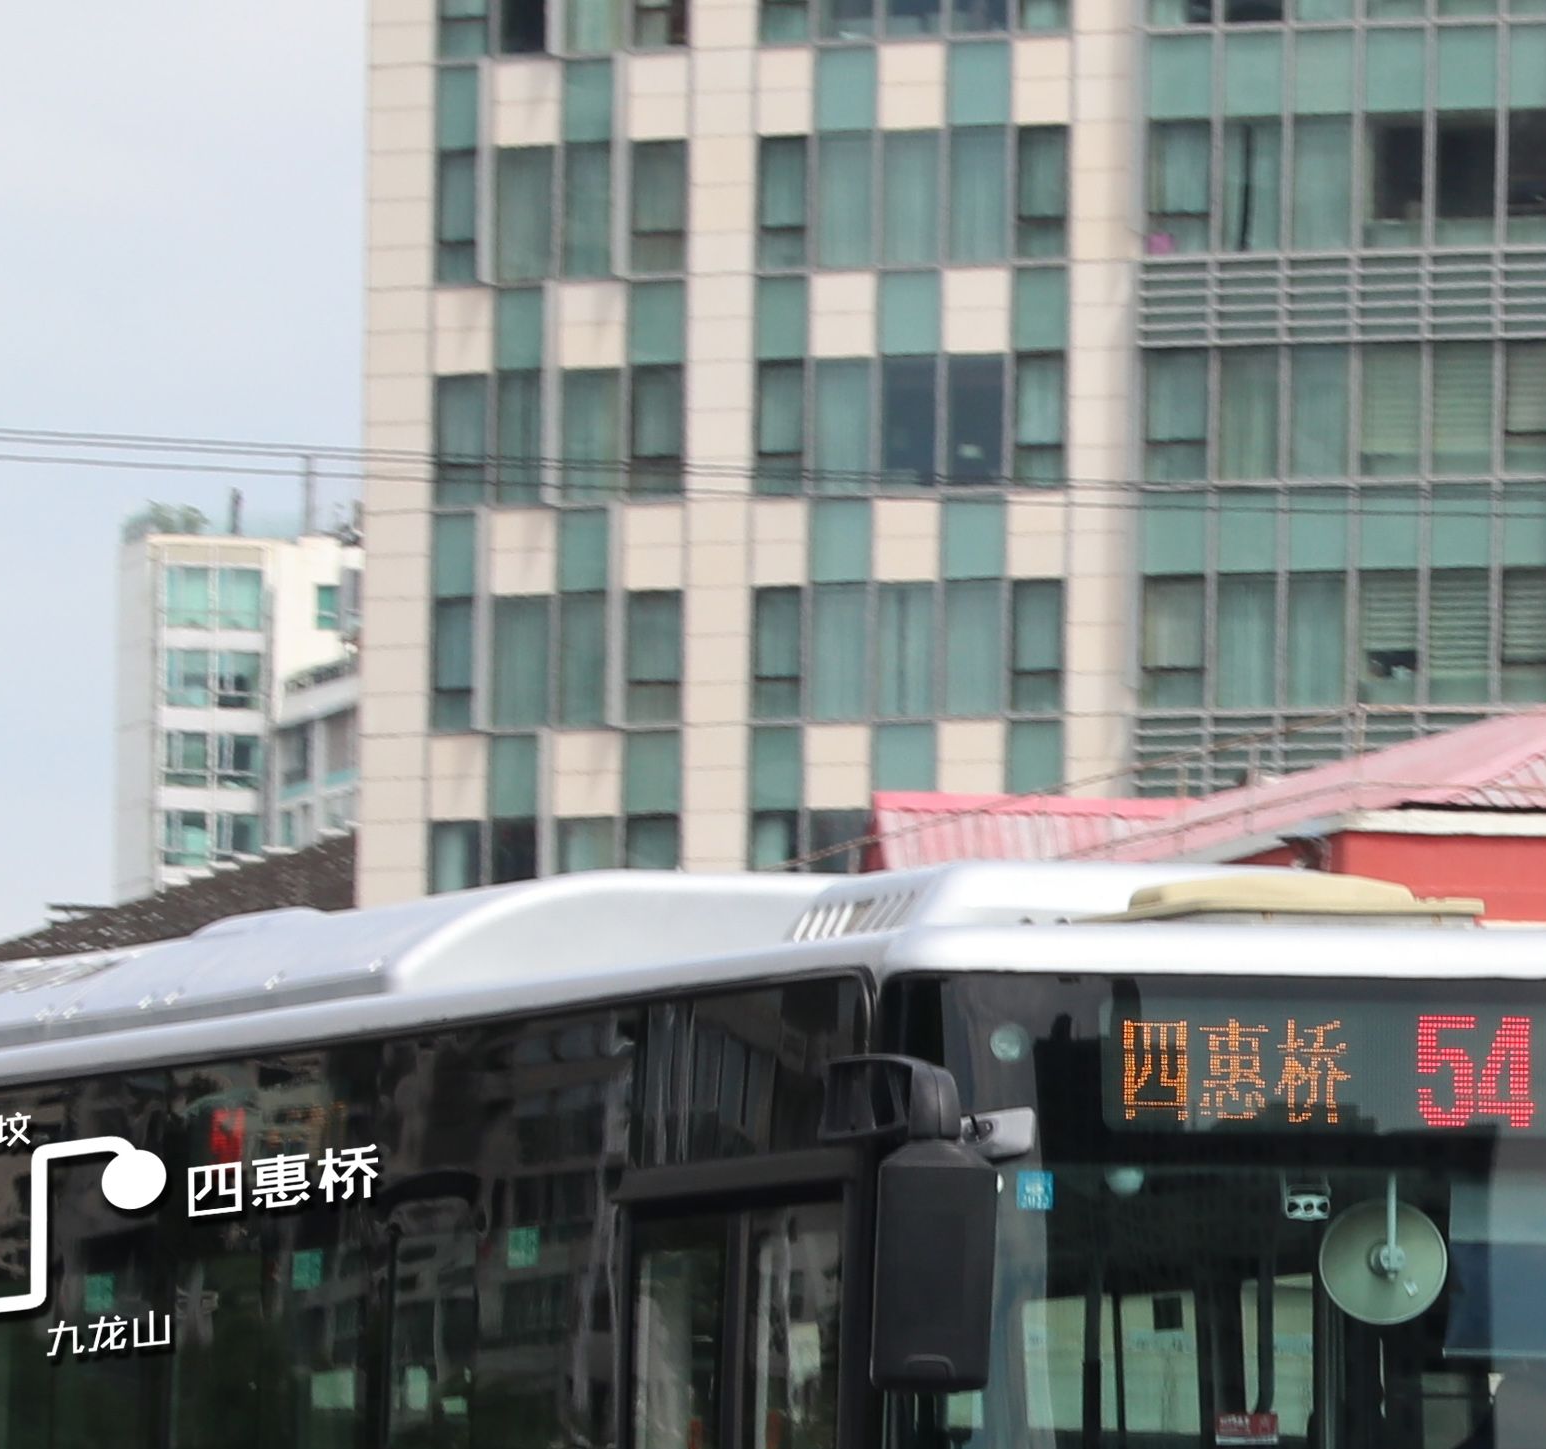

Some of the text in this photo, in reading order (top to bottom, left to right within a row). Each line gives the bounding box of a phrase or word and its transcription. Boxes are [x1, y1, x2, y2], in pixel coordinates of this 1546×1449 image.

[1122, 1017, 1351, 1124] 四惠桥
[1417, 1015, 1535, 1128] 54
